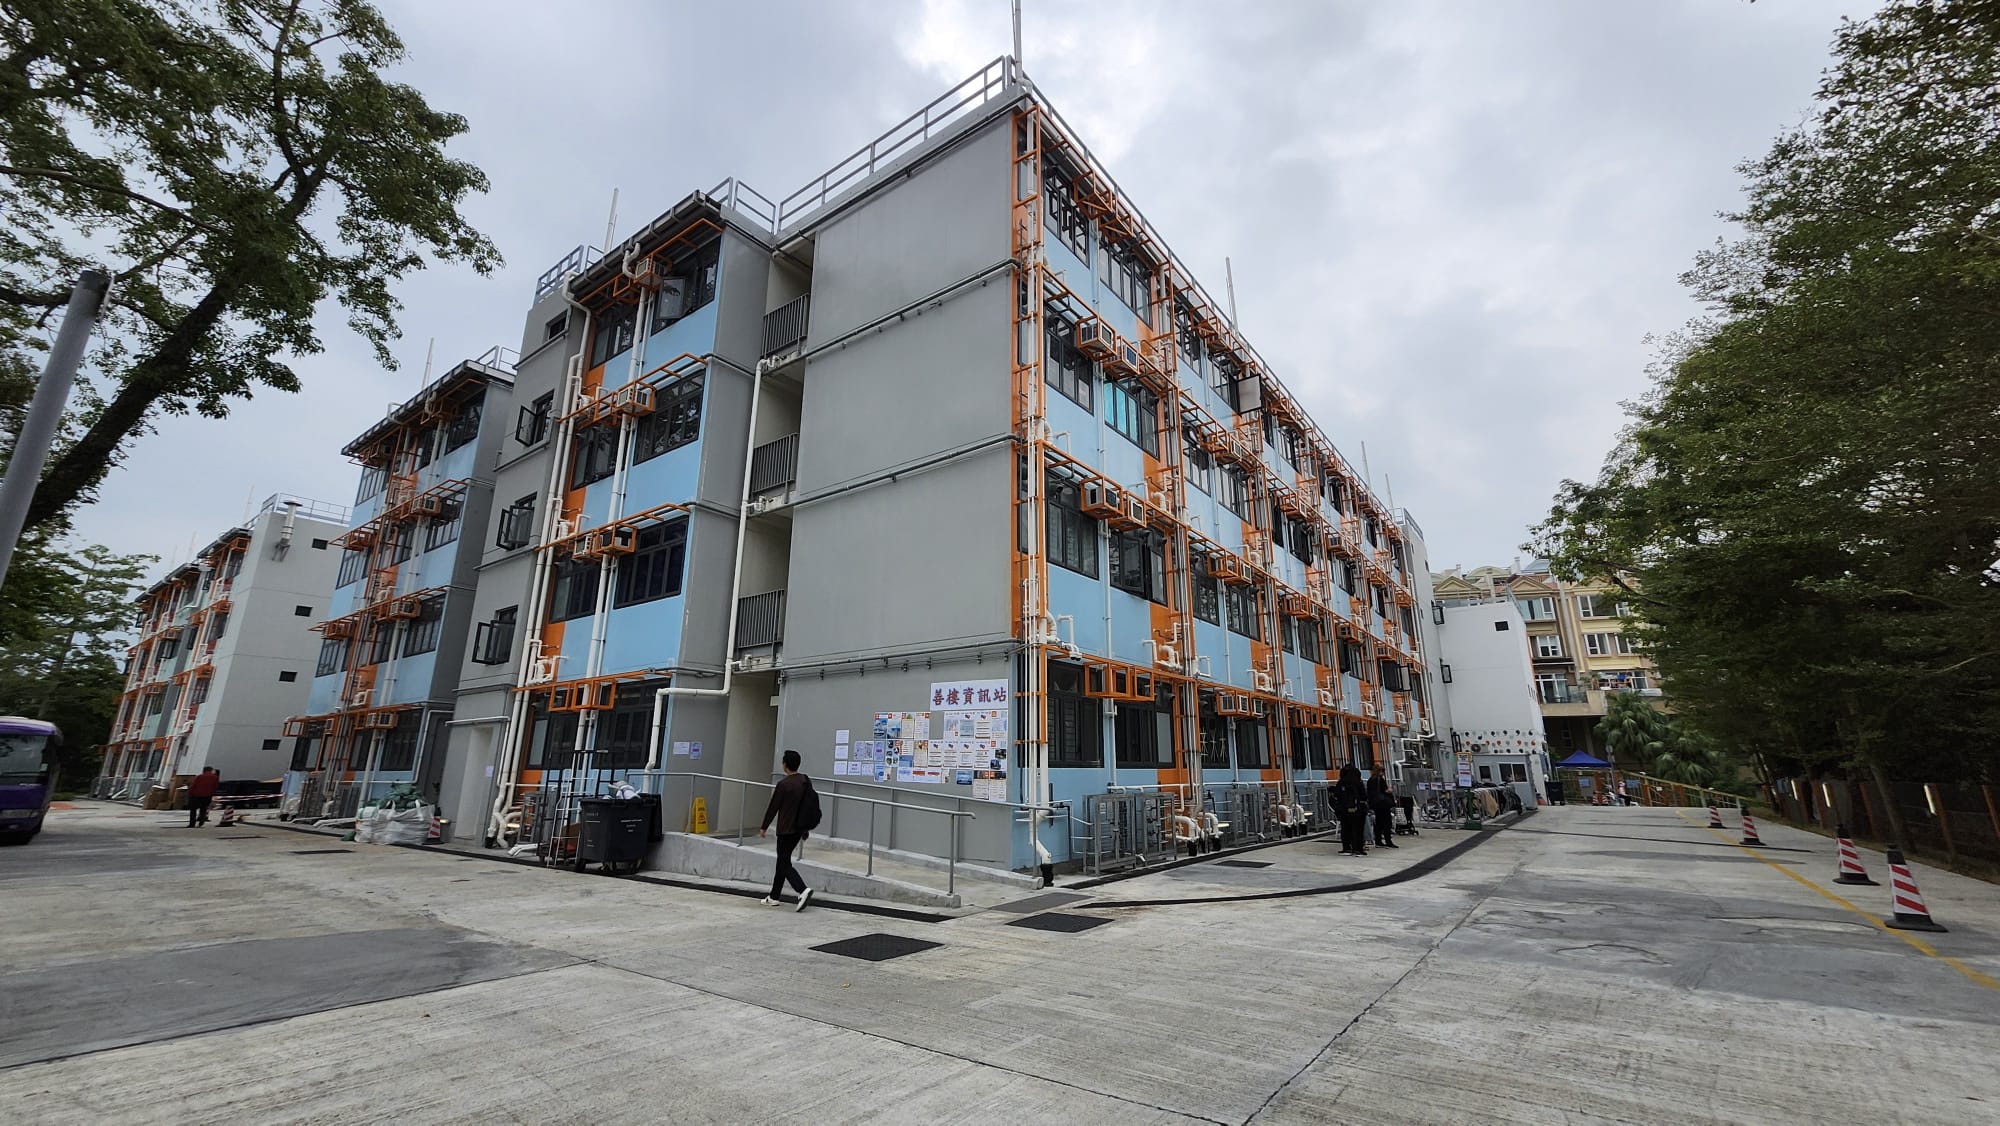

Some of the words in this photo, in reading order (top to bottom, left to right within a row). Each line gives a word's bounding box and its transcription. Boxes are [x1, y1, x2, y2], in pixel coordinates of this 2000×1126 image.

[933, 687, 1007, 705] 善樓資訊站
